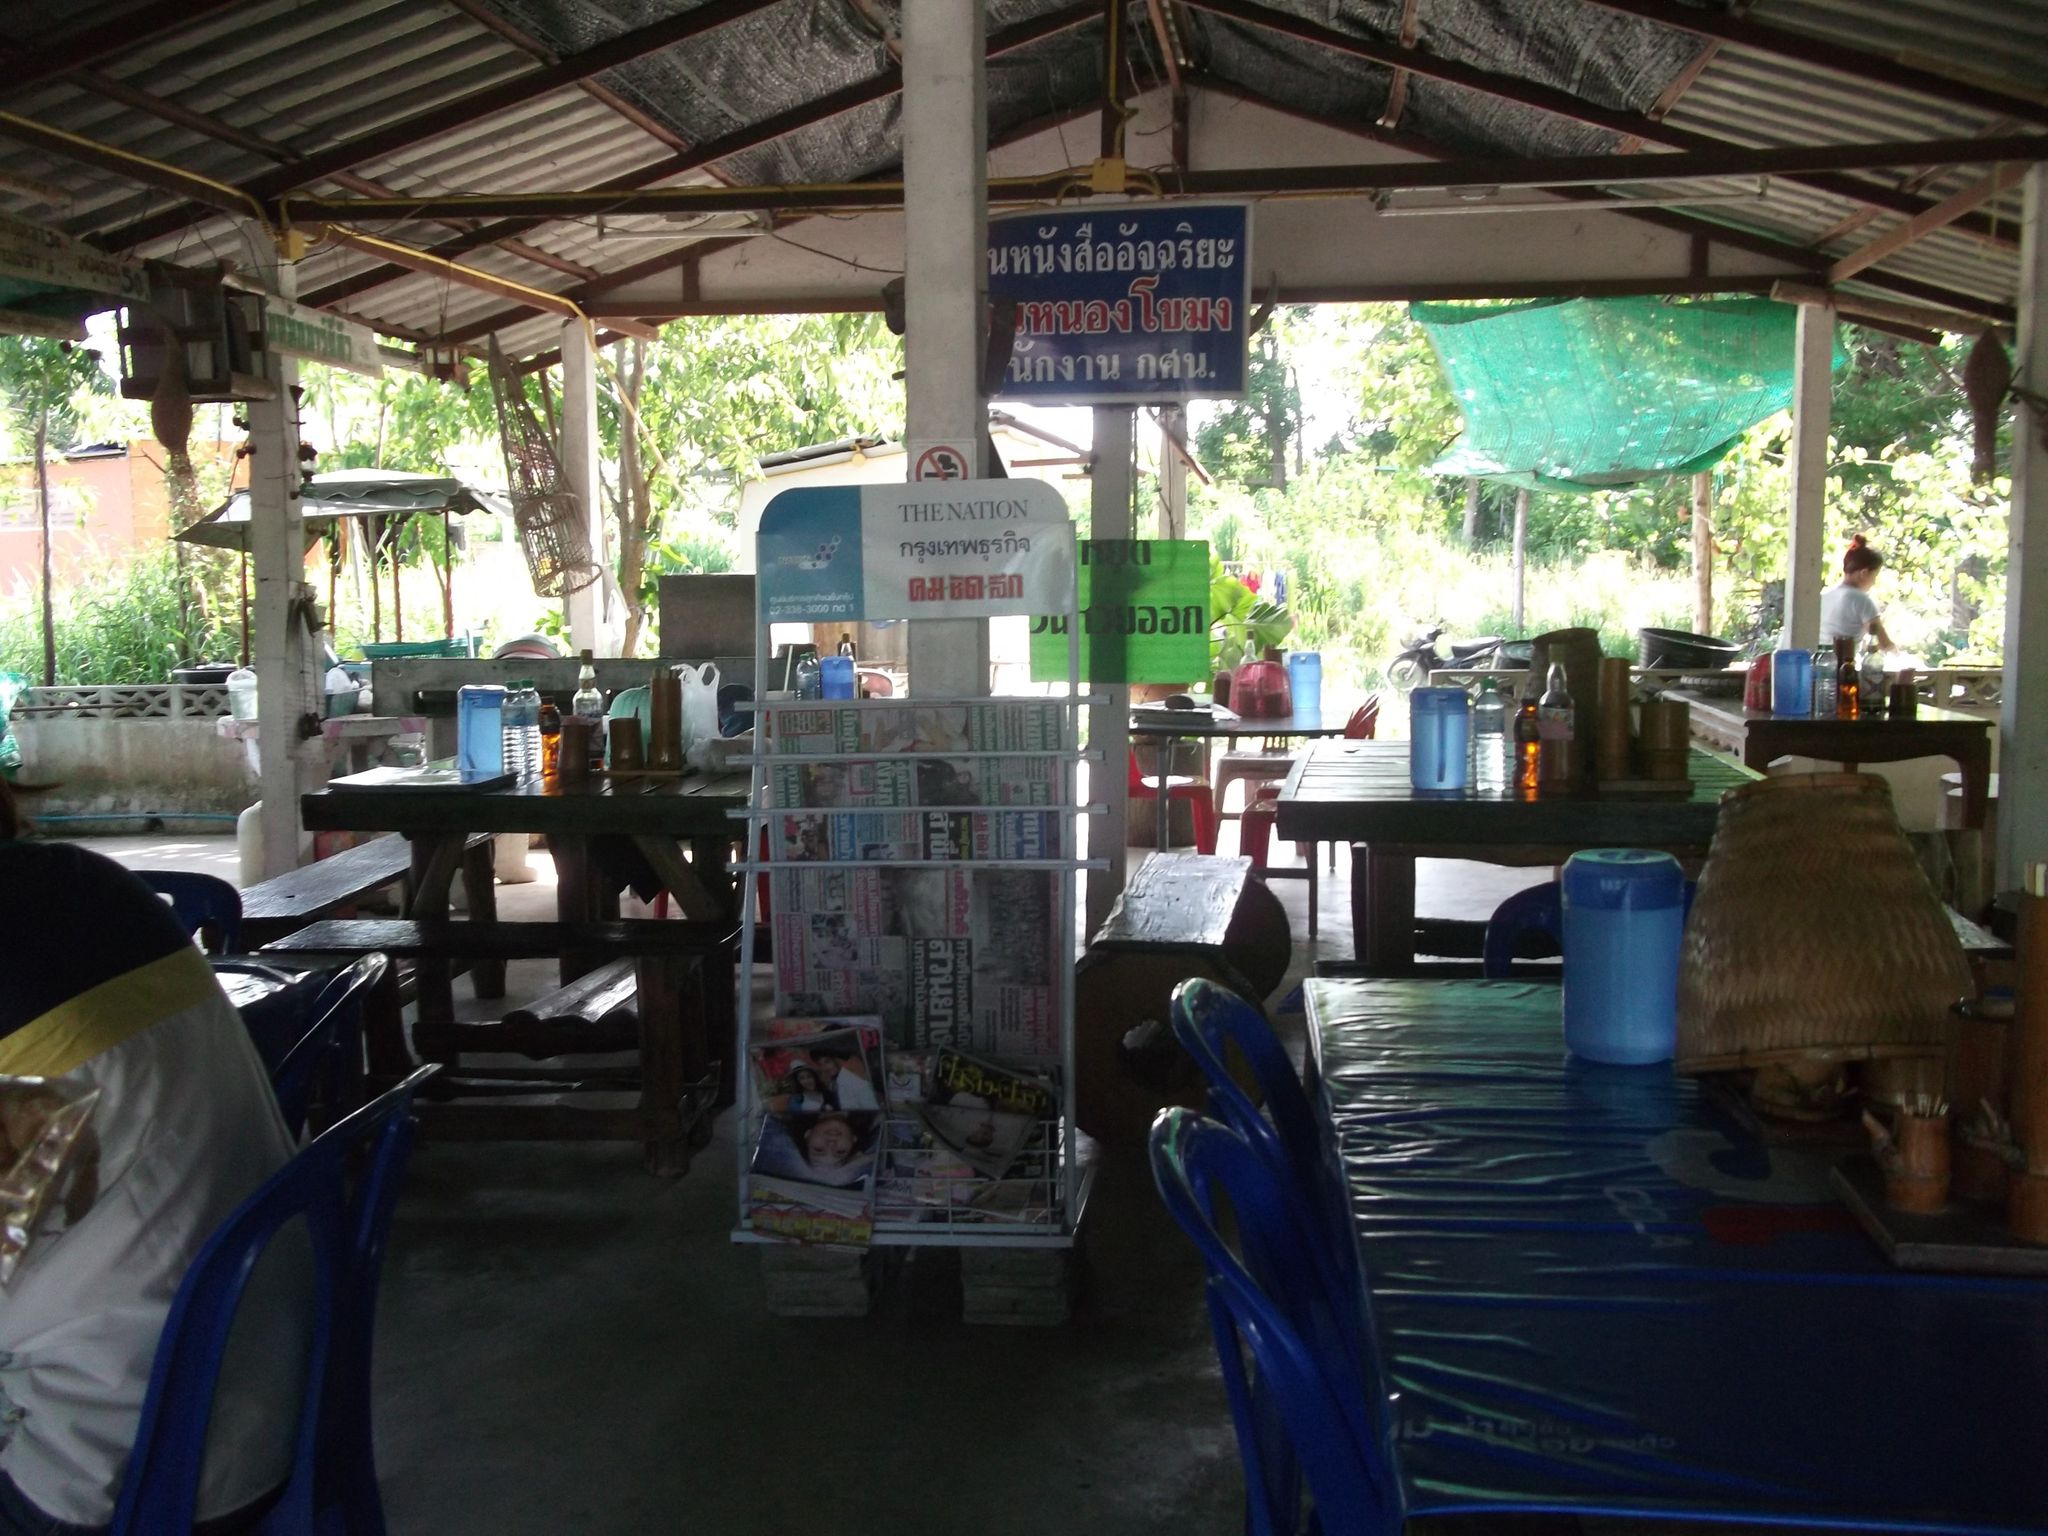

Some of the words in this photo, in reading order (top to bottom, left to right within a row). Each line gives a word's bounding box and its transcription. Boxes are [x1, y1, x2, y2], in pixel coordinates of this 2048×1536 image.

[898, 504, 944, 523] THE
[946, 499, 1029, 520] NATION
[899, 530, 1032, 565] กรุงเทพธุรกิจ
